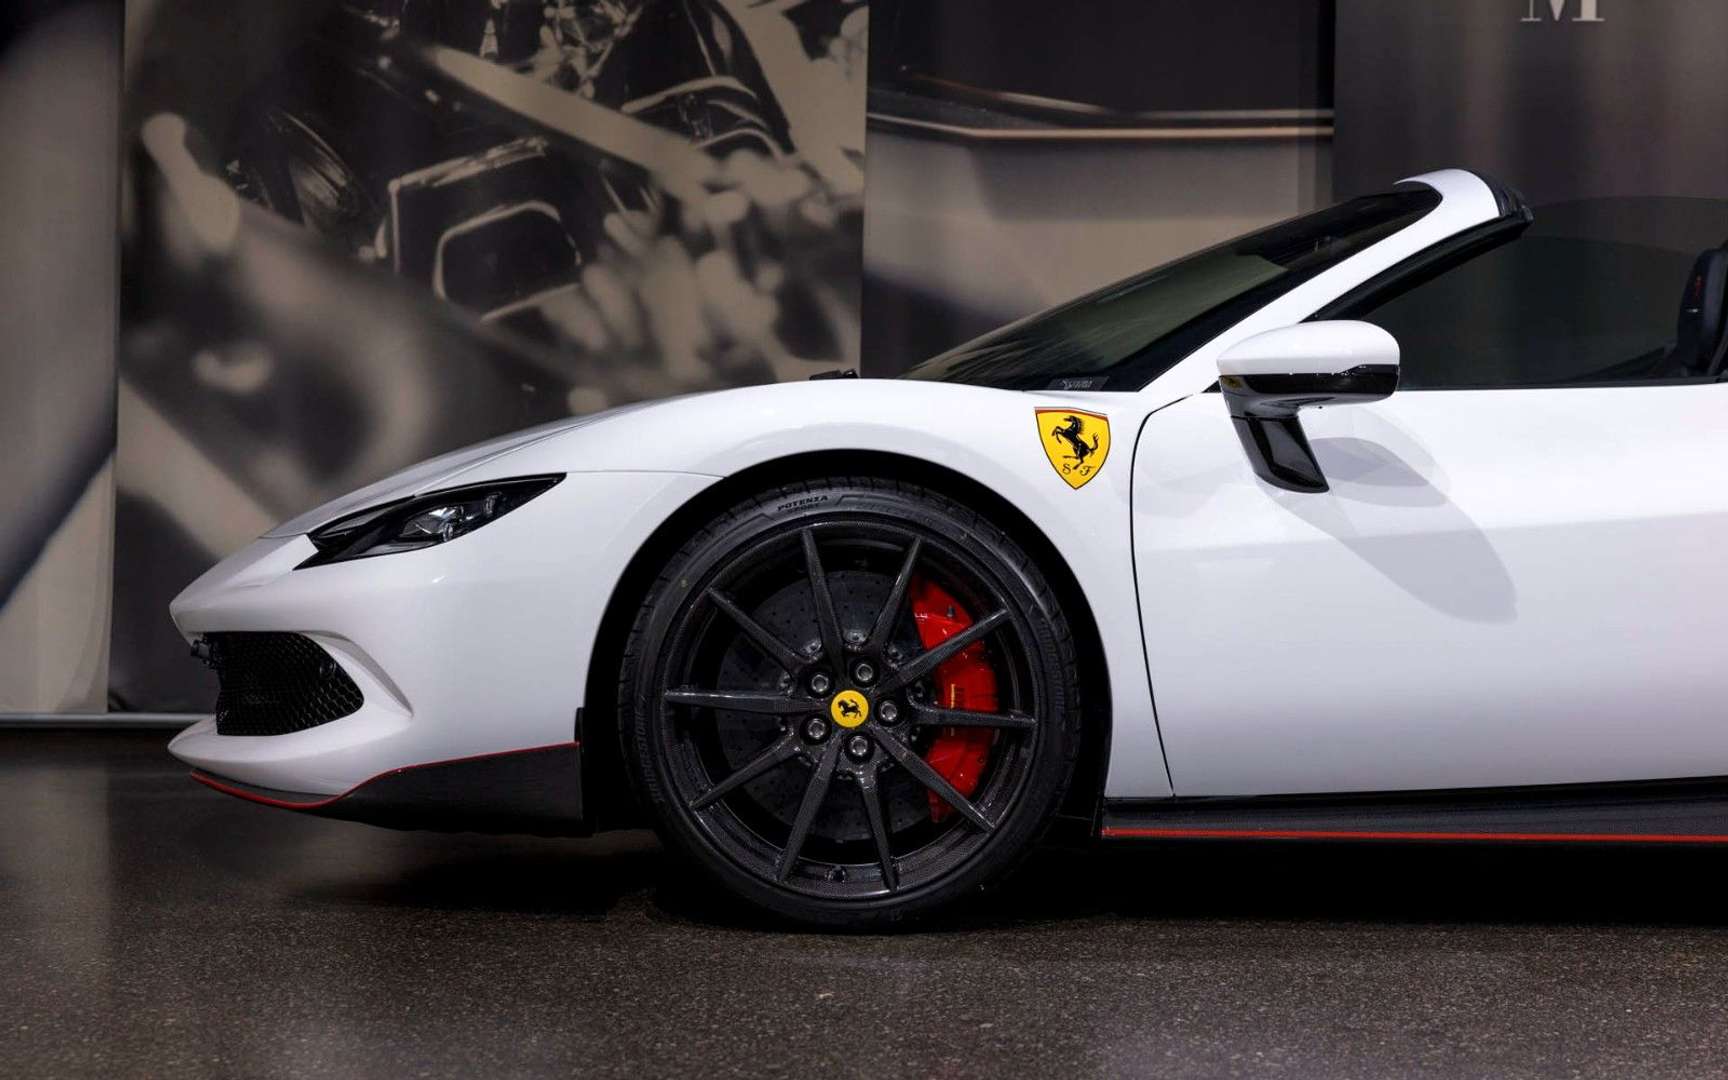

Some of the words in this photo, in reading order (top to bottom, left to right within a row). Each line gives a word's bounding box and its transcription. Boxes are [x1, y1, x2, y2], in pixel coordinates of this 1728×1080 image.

[1062, 463, 1072, 475] S
[1079, 465, 1097, 477] F
[777, 495, 829, 511] POTENZA
